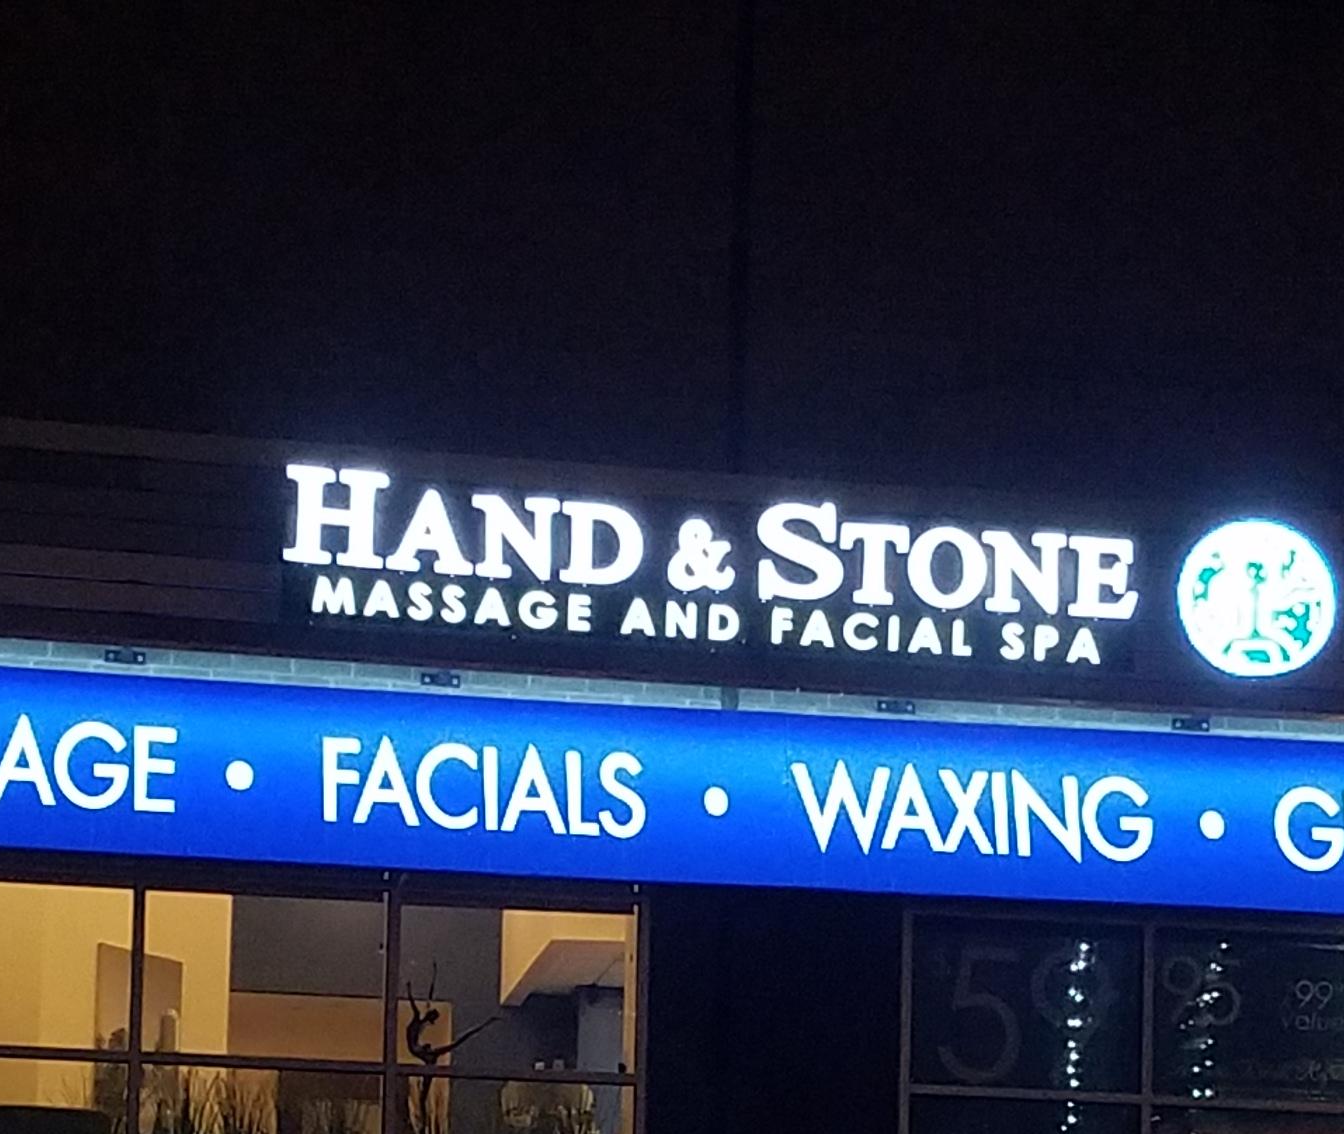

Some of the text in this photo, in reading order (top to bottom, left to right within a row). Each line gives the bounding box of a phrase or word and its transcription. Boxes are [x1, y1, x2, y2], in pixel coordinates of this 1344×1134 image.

[281, 462, 1140, 621] HAND & STONE
[311, 574, 1102, 666] MASSAGE AND FACIAL SPA
[321, 735, 647, 840] FACIALS
[790, 759, 1154, 864] WAXING
